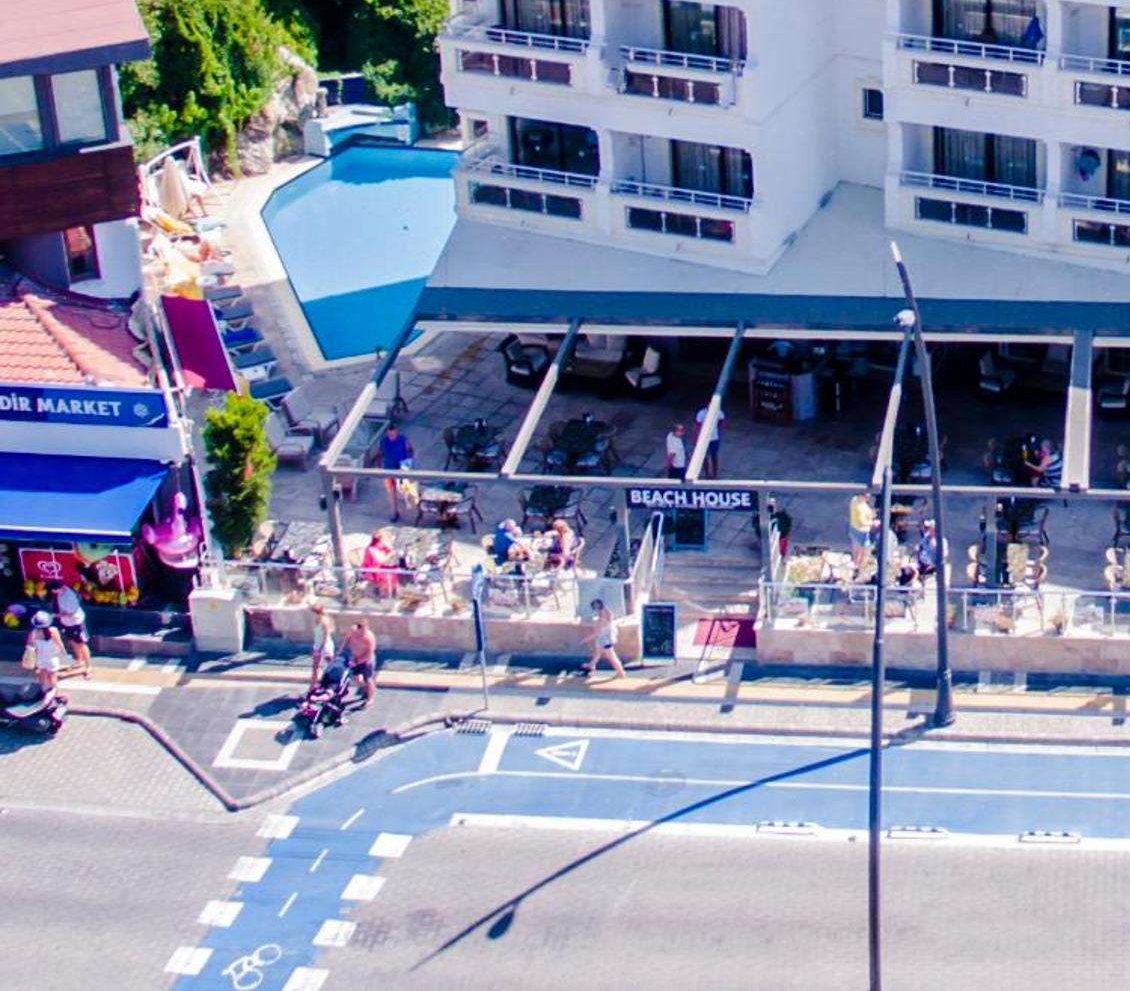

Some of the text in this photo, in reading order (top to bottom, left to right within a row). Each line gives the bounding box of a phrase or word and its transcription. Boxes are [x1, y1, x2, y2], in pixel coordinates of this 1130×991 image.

[37, 398, 121, 417] MARKET
[630, 490, 751, 507] BEACH HOUSE
